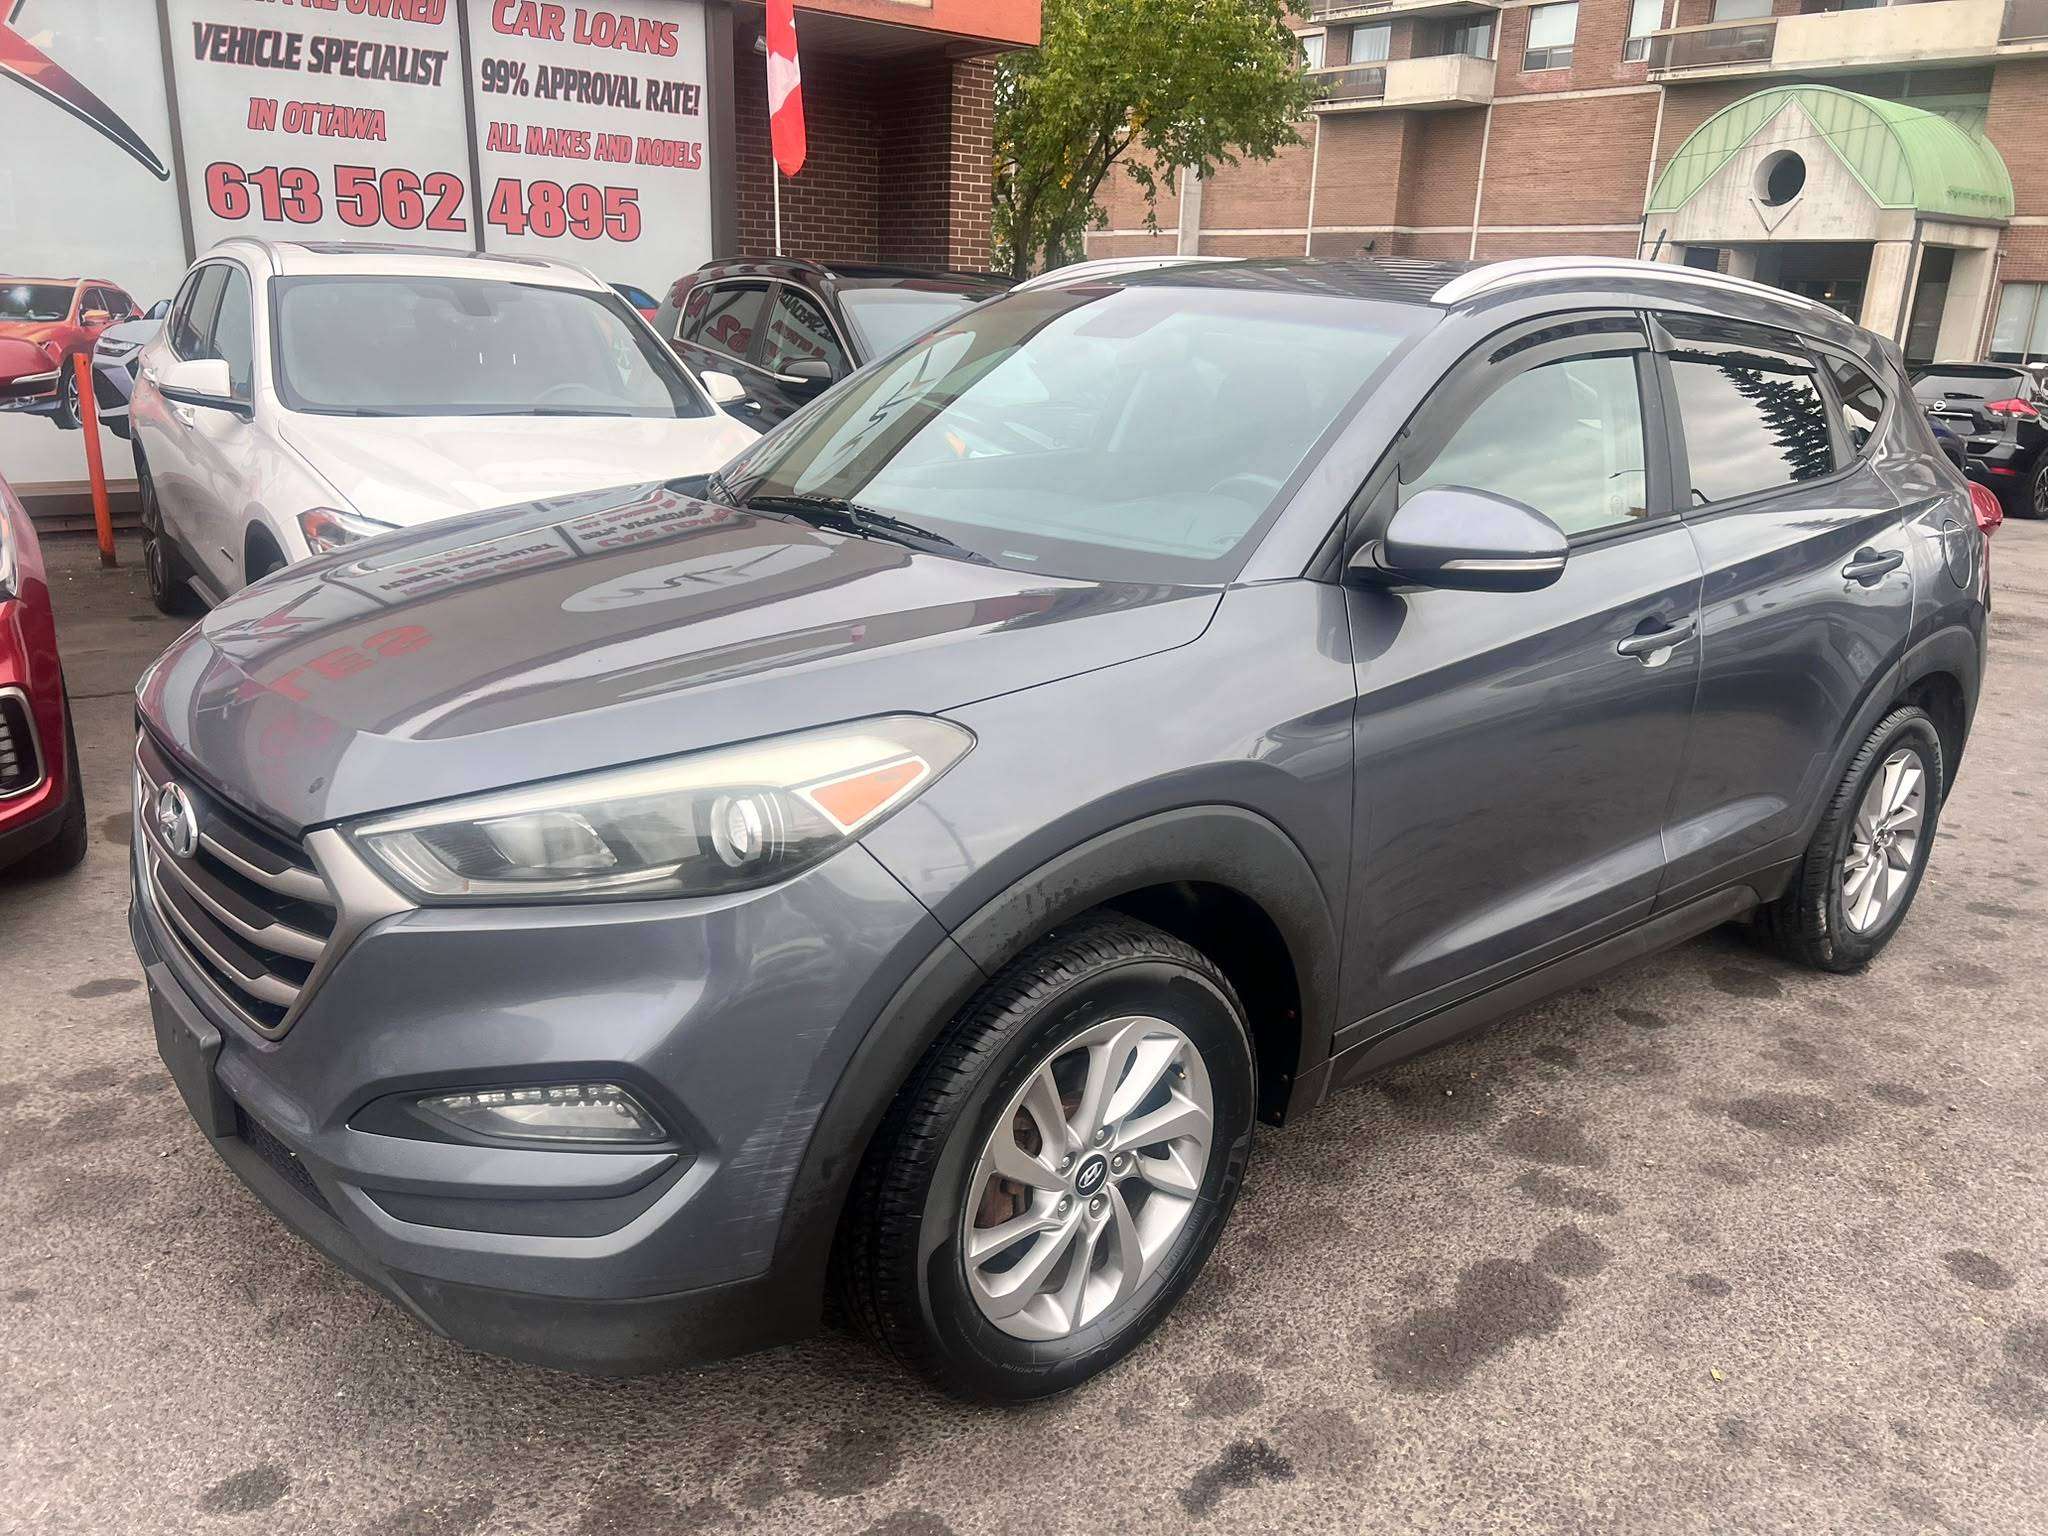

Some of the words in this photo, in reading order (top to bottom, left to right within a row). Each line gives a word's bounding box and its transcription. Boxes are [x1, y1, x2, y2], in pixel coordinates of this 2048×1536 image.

[192, 22, 303, 71] VEHICLE
[307, 36, 449, 87] SPECIALIST
[492, 0, 566, 41] CAR
[573, 9, 679, 57] LOANS
[481, 58, 530, 97] 99%
[534, 65, 641, 110] APPROVAL
[645, 79, 701, 117] RATE!
[248, 97, 279, 131] IN
[283, 101, 387, 142] OTTAWA
[486, 122, 522, 154] ALL
[525, 126, 592, 161] MAKES
[593, 132, 633, 164] AND
[635, 137, 702, 171] MODELS
[205, 162, 322, 224] 613
[333, 164, 467, 233] 562
[487, 178, 642, 242] 4895
